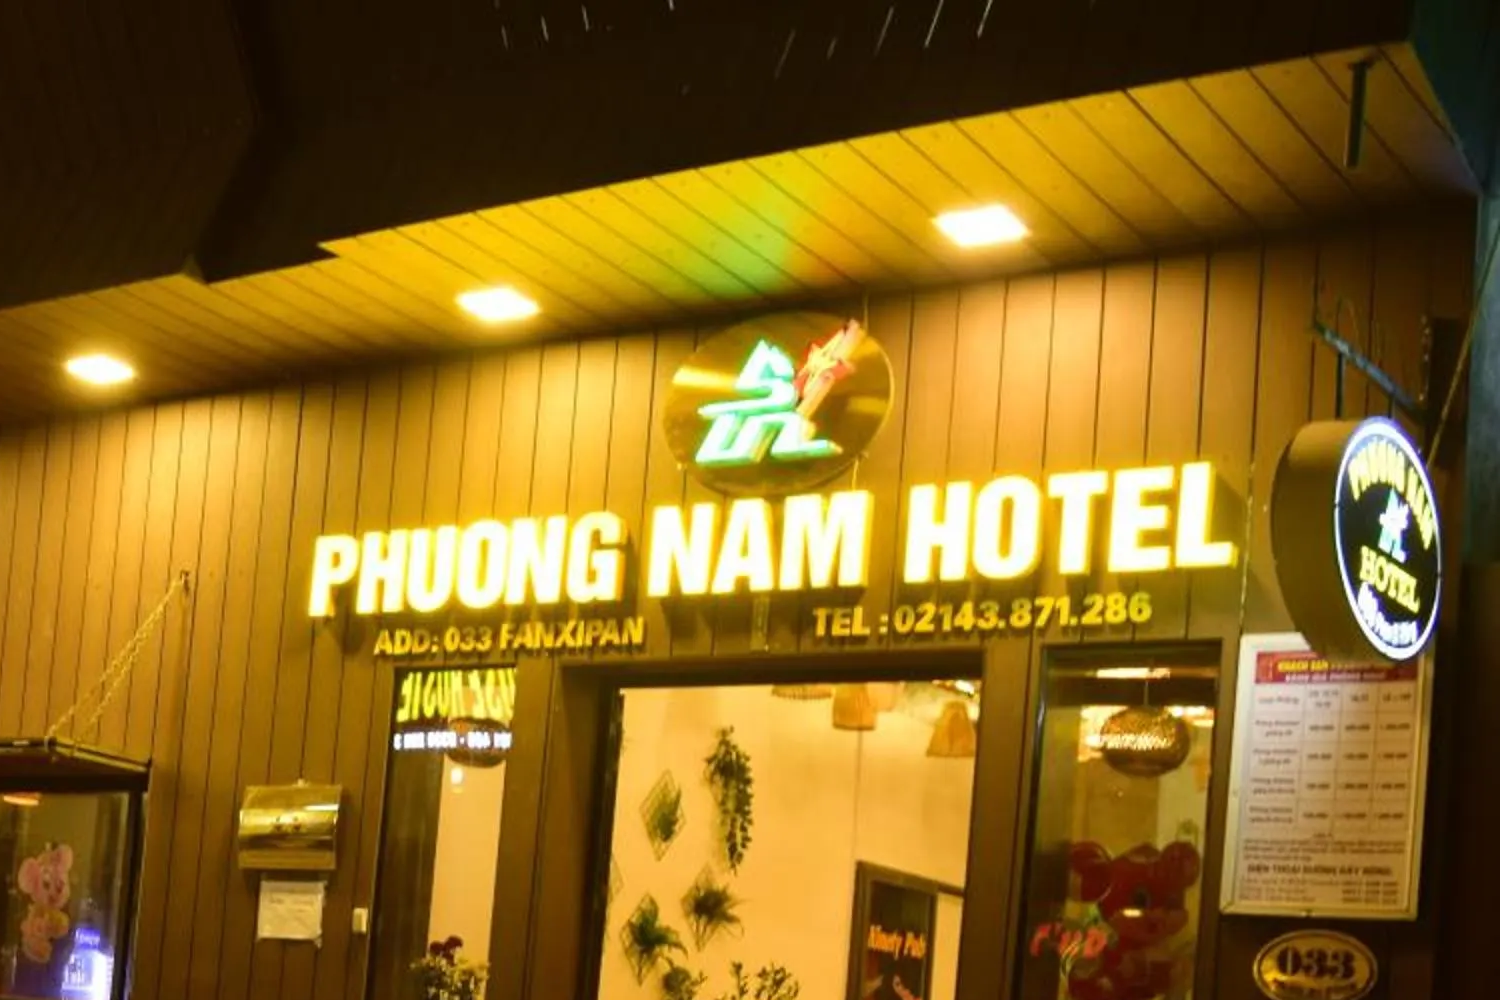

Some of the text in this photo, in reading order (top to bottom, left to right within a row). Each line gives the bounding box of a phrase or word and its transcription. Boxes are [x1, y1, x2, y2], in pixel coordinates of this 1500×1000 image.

[308, 462, 1238, 617] PHUONG NAM HOTEL
[1360, 545, 1420, 613] HOTEL
[894, 592, 1153, 633] 02143.871.286
[373, 616, 645, 654] ADD: 033 FANXIPAN
[1277, 946, 1356, 978] 033
